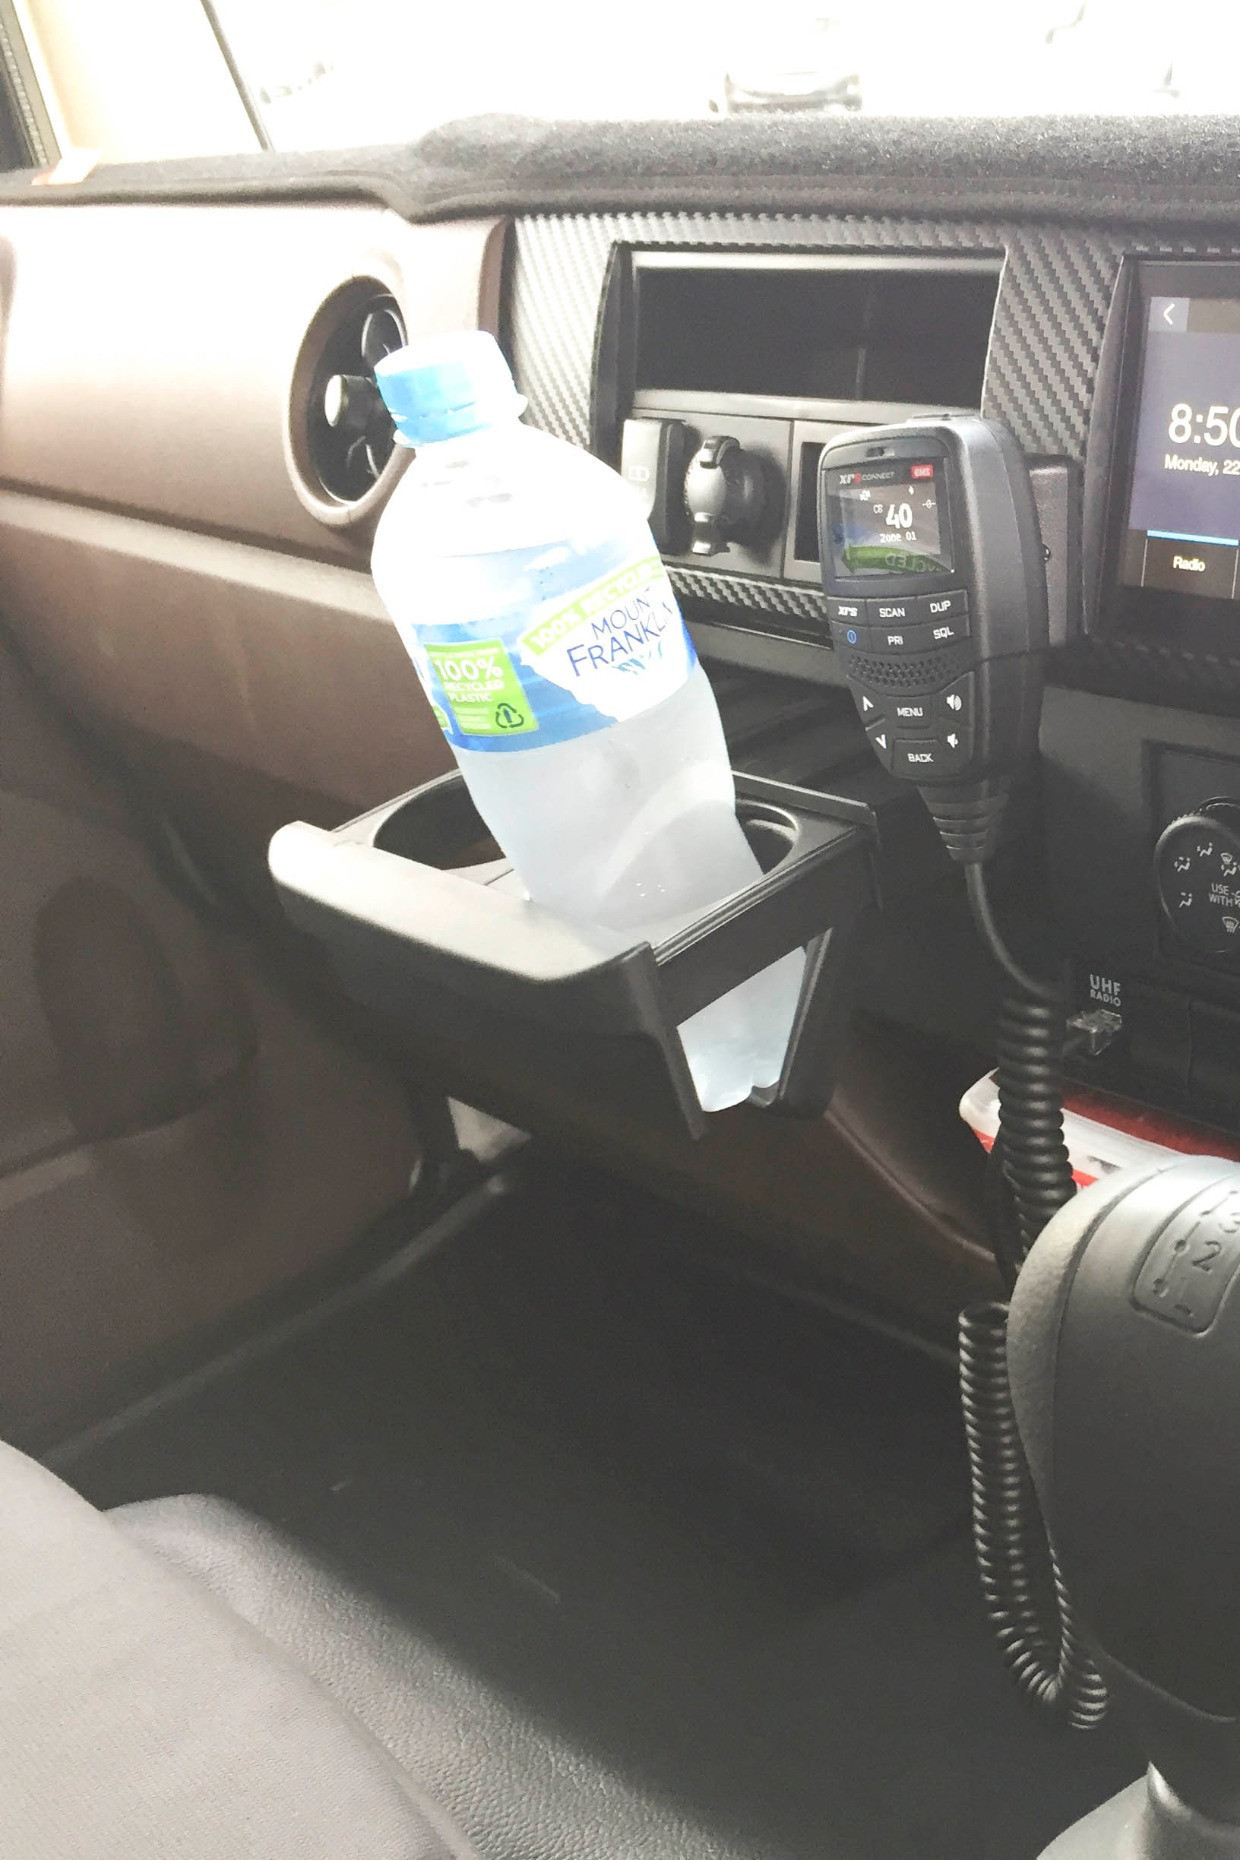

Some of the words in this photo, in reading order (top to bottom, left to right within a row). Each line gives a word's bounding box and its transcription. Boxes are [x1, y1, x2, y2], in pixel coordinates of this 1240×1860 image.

[1165, 454, 1219, 477] Monday,
[1223, 460, 1240, 475] 22
[885, 503, 913, 529] 40
[1173, 555, 1206, 572] Radio
[879, 608, 906, 618] SCAN
[930, 600, 951, 613] DUP
[933, 627, 954, 639] SQL
[887, 635, 903, 645] PRI
[434, 656, 503, 681] 100%
[897, 707, 923, 717] MENU
[908, 753, 934, 763] BACK
[1211, 883, 1229, 896] USE
[1209, 893, 1233, 907] WITH
[1089, 974, 1121, 996] UHF
[1090, 989, 1122, 1007] RADIO
